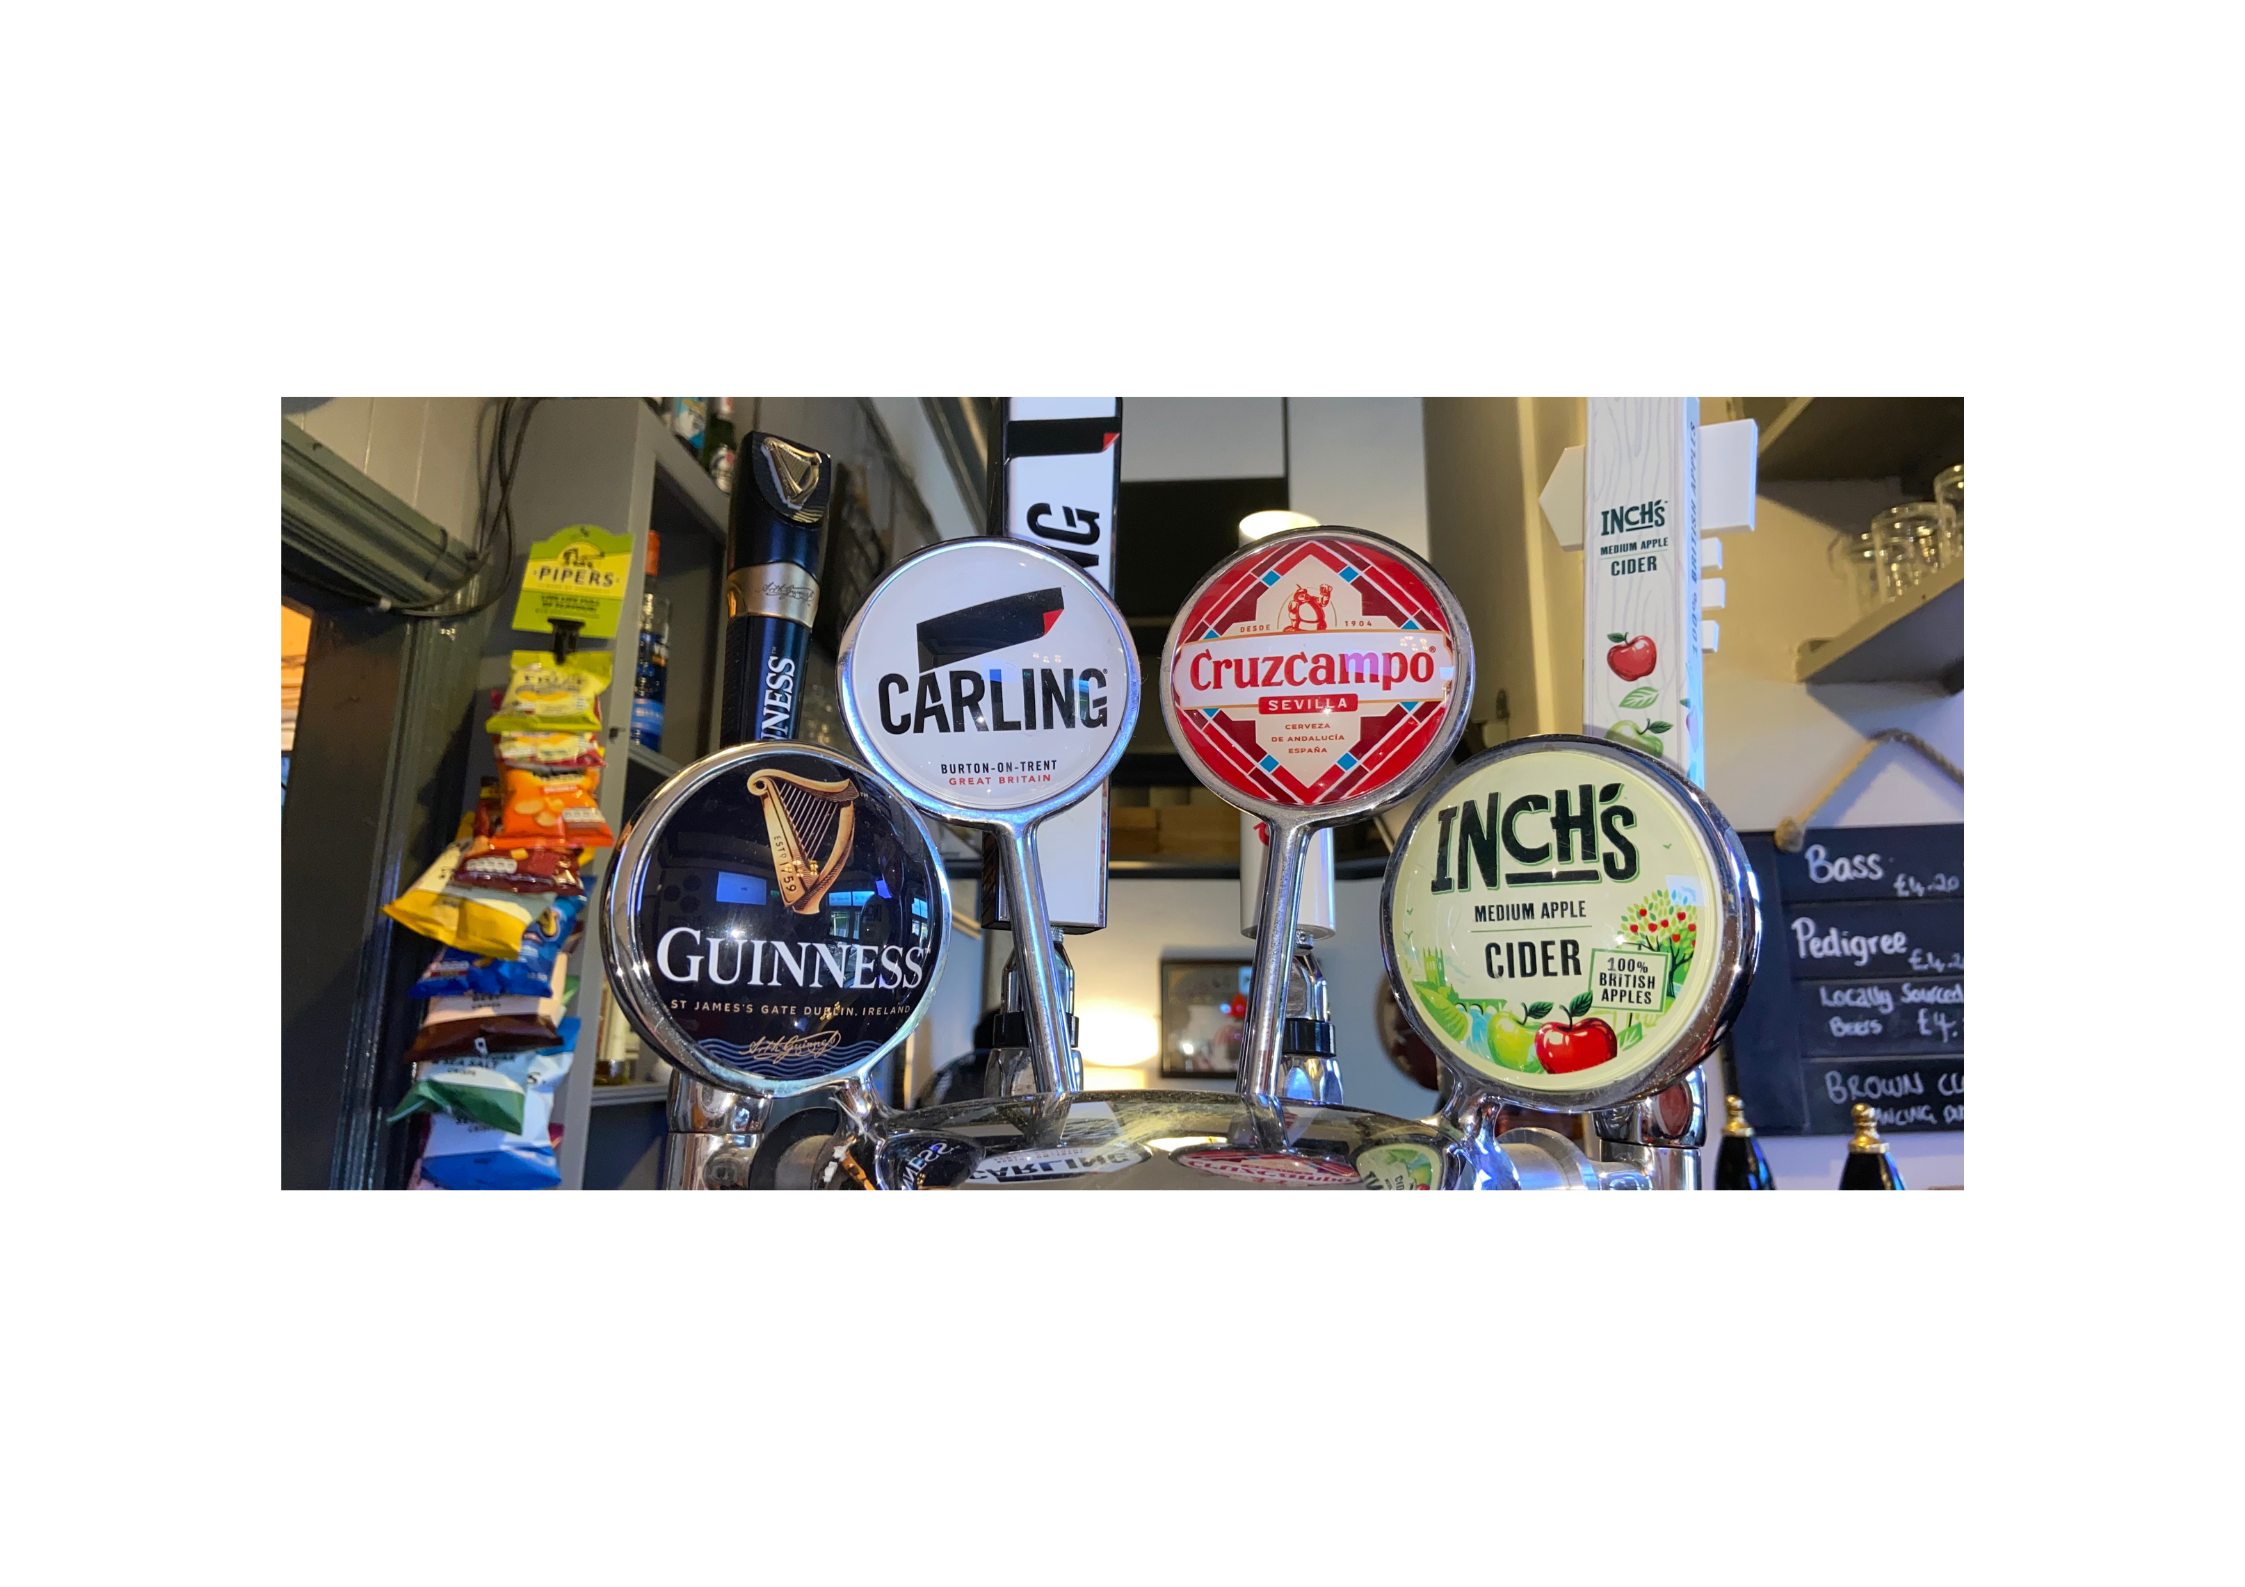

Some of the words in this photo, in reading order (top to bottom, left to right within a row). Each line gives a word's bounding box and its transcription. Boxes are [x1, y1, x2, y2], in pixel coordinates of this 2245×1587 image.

[1600, 541, 1638, 555] MEDIUM
[1640, 537, 1668, 550] APPLE
[1611, 555, 1657, 576] CIDER
[538, 566, 615, 588] PIPERS
[1240, 623, 1271, 633] DESDE
[1344, 620, 1373, 628] 1904
[1189, 648, 1434, 691] Cruzcampo
[761, 656, 795, 739] NESS
[878, 668, 1108, 735] CARLING
[1268, 697, 1348, 712] SEVILLA
[1287, 733, 1345, 743] ANDALUCÍA
[1288, 745, 1328, 755] ESPAÑA
[940, 759, 1058, 775] BURTON-ON-TRENT
[949, 776, 991, 786] GREAT
[998, 773, 1052, 785] BRITAIN
[1805, 843, 1884, 884] Bass
[779, 862, 797, 892] 1759
[1893, 872, 1960, 897] £4.20
[1473, 903, 1536, 923] MEDIUM
[1540, 900, 1587, 920] APPLE
[1790, 916, 1908, 968] Pedigree
[656, 926, 924, 989] GUINNESS
[1484, 939, 1582, 980] CIDER
[1607, 957, 1649, 974] 100%
[1599, 972, 1656, 990] BRITISH
[1600, 987, 1653, 1006] APPLES
[1819, 985, 1894, 1014] Locally
[1900, 982, 1964, 1004] Sourced
[671, 1000, 687, 1010] ST
[694, 1002, 754, 1013] JAMES'S
[761, 1004, 797, 1015] GATE
[862, 1005, 911, 1016] IRELAND
[1825, 1070, 1924, 1104] BROWN
